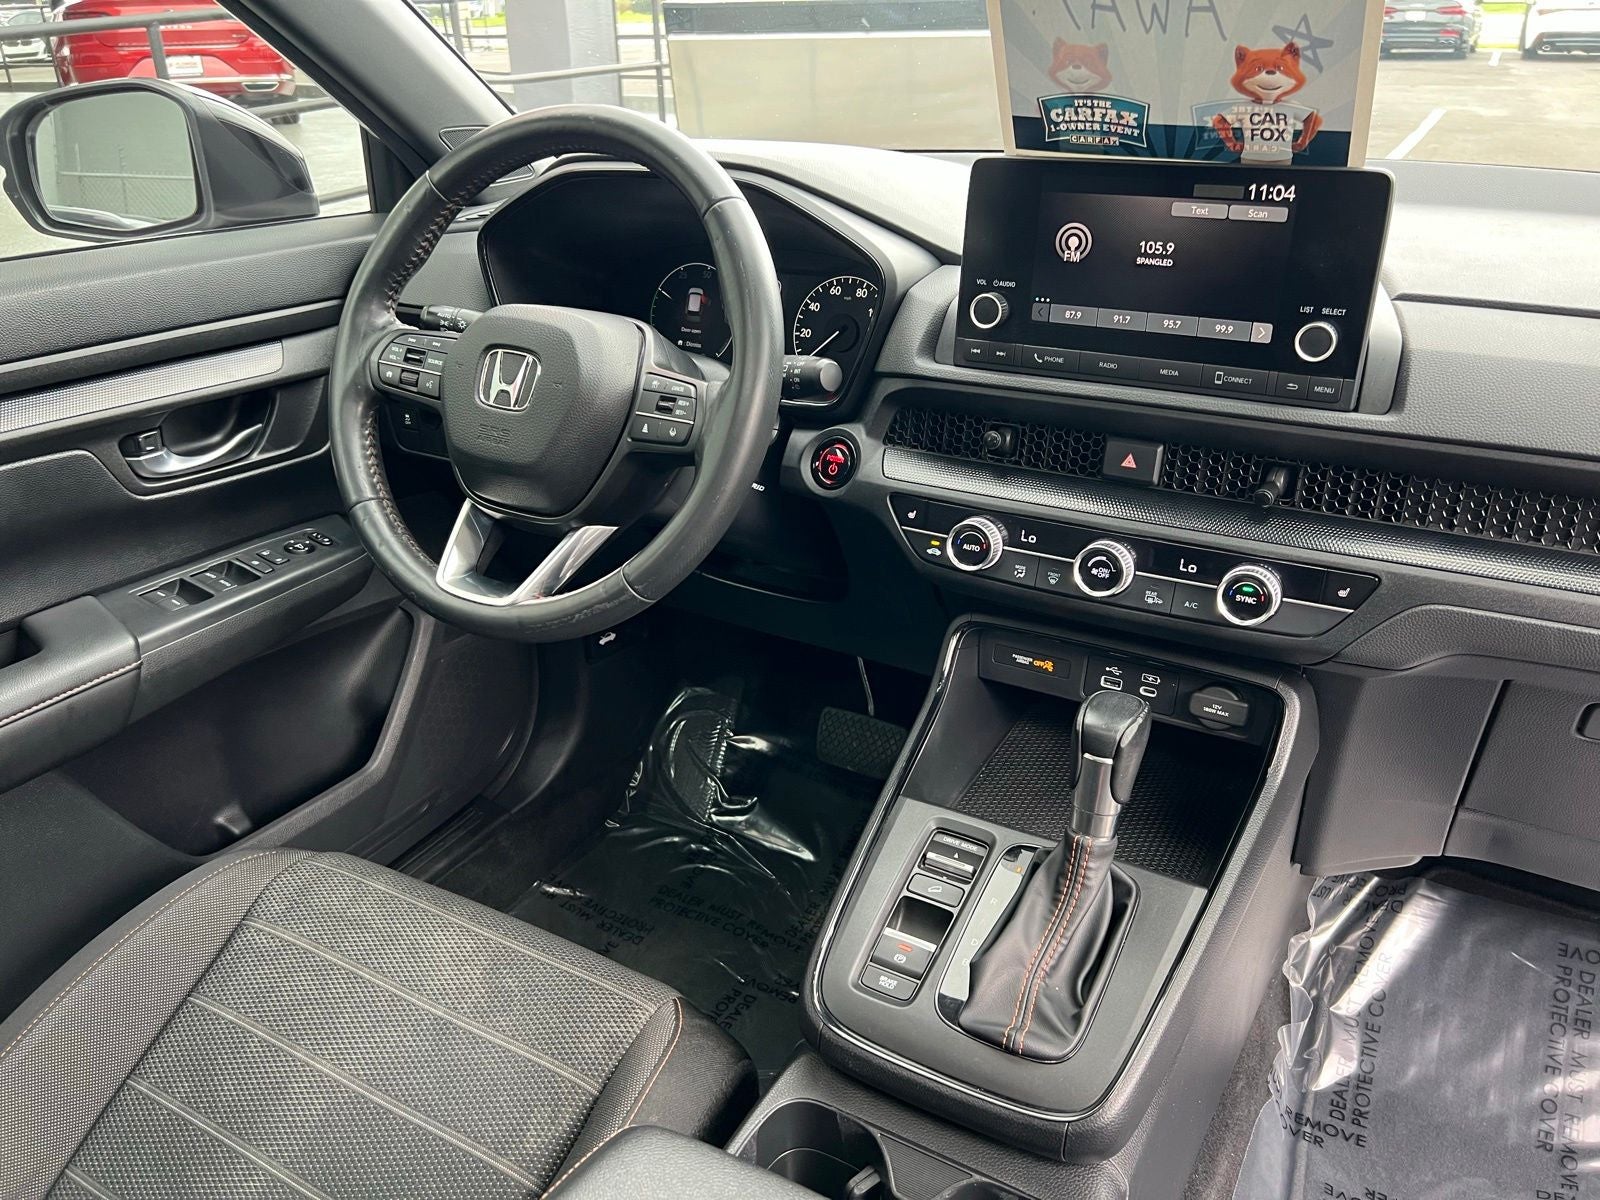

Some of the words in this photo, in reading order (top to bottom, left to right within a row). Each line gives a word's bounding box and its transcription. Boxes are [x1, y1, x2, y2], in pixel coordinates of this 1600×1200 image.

[1093, 100, 1112, 108] THE
[1050, 106, 1139, 127] CARFAX
[1249, 112, 1288, 126] CAR
[1050, 122, 1101, 132] 1-OWNER
[1102, 123, 1140, 137] EVENT
[1250, 127, 1287, 142] FOX
[1071, 134, 1119, 146] CARFAX
[1247, 183, 1297, 203] 11:04
[1191, 206, 1209, 216] Text
[1248, 209, 1268, 219] Scan
[1138, 240, 1175, 256] 105.9
[1063, 250, 1081, 264] FM
[1136, 257, 1174, 267] SPANGLED
[976, 278, 987, 286] VOL
[999, 280, 1016, 288] AUDIO
[829, 285, 842, 296] 60
[855, 288, 868, 298] 80
[808, 302, 821, 312] 40
[1300, 305, 1314, 314] LIST
[1321, 307, 1347, 316] SELECT
[1064, 310, 1083, 321] 87.9
[1113, 314, 1131, 325] 91.7
[1163, 319, 1182, 330] 95.7
[1215, 324, 1234, 335] 99.9
[799, 327, 812, 338] 20
[1044, 355, 1065, 364] PHONE
[1098, 361, 1118, 370] RADIO
[1159, 368, 1179, 377] MEDIA
[1223, 376, 1253, 385] CONNECT
[1314, 385, 1335, 394] MENU
[1020, 529, 1037, 544] Lo
[962, 543, 981, 552] AUTO
[1179, 558, 1198, 573] Lo
[1097, 572, 1110, 580] OFF
[1184, 601, 1199, 610] A/C
[1235, 595, 1257, 605] SYNC
[943, 836, 960, 847] DRIVE
[961, 840, 978, 851] MODE
[878, 979, 895, 990] HOLD
[879, 974, 898, 985] BRAKE
[1573, 969, 1596, 1040] DEALER
[718, 993, 758, 1030] DEALE
[1544, 964, 1573, 1077] PROTECTIVE
[1351, 1021, 1383, 1129] PROTECTIVE
[1368, 952, 1393, 1020] COVER
[1329, 1055, 1351, 1122] DEALER
[1342, 998, 1362, 1047] MUST
[1567, 1049, 1588, 1104] MUST
[1535, 1083, 1560, 1153] COVER
[1285, 1105, 1368, 1148] REMOVE
[1560, 1112, 1581, 1192] REMOVE
